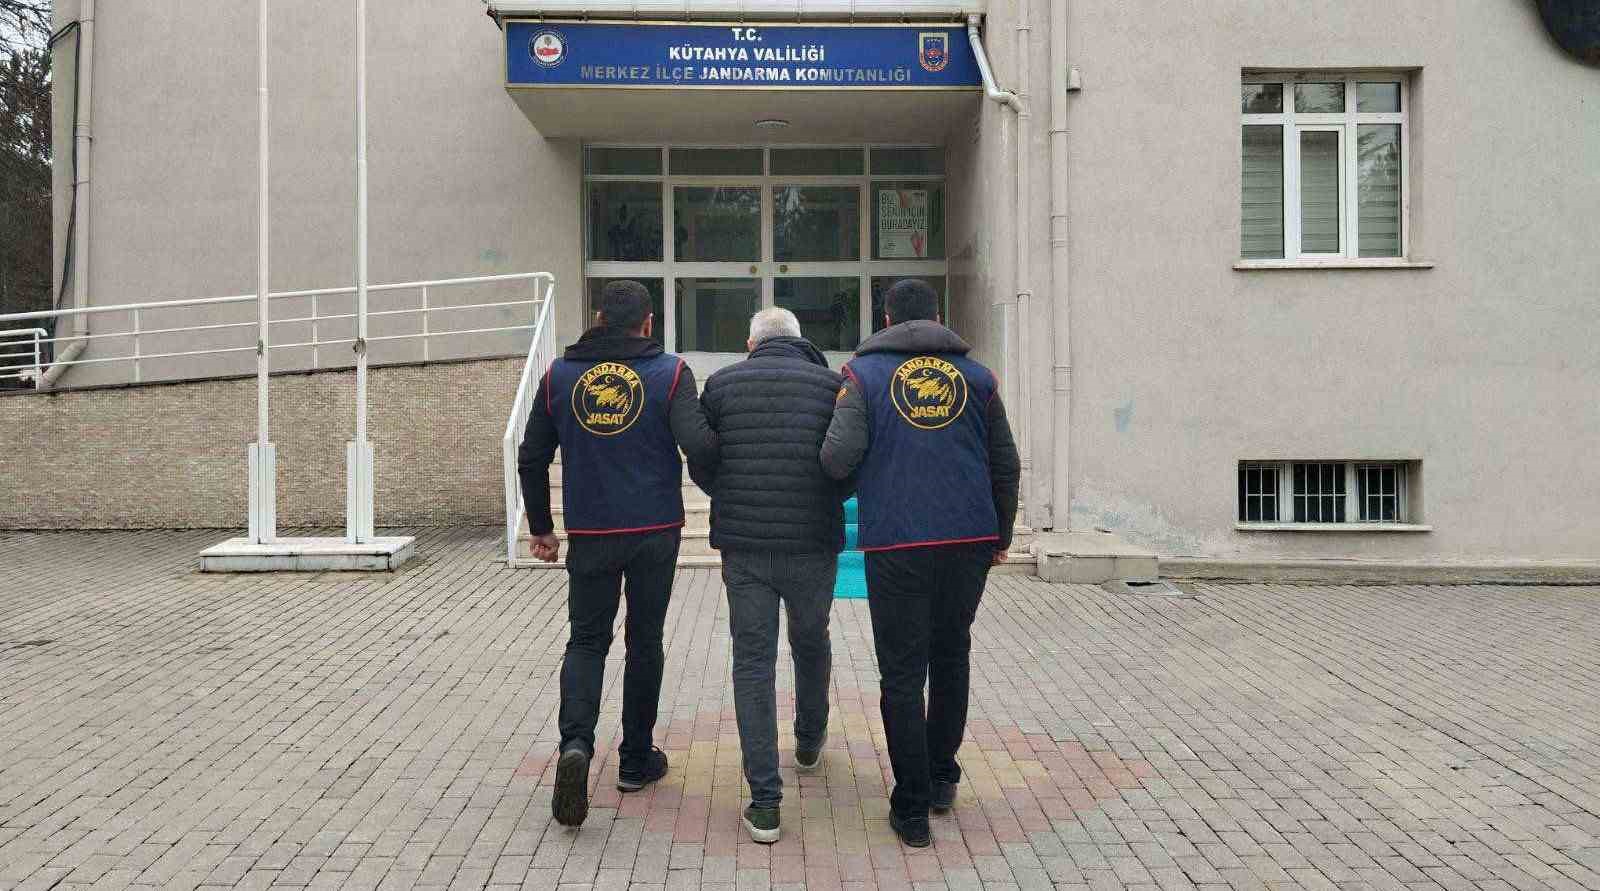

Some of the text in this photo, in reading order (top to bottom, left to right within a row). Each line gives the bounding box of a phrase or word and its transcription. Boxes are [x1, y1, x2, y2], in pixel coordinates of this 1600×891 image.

[732, 28, 762, 41] T.C.
[669, 44, 825, 61] KÜTAHYA VALİLİĞİ
[580, 63, 911, 83] MERKEZ İLÇE JANDARMA KOMUTANLIĞI
[898, 357, 959, 380] JANDARMA
[581, 364, 640, 391] JANDARMA
[585, 413, 625, 425] JASAT
[910, 405, 951, 418] JASAT
